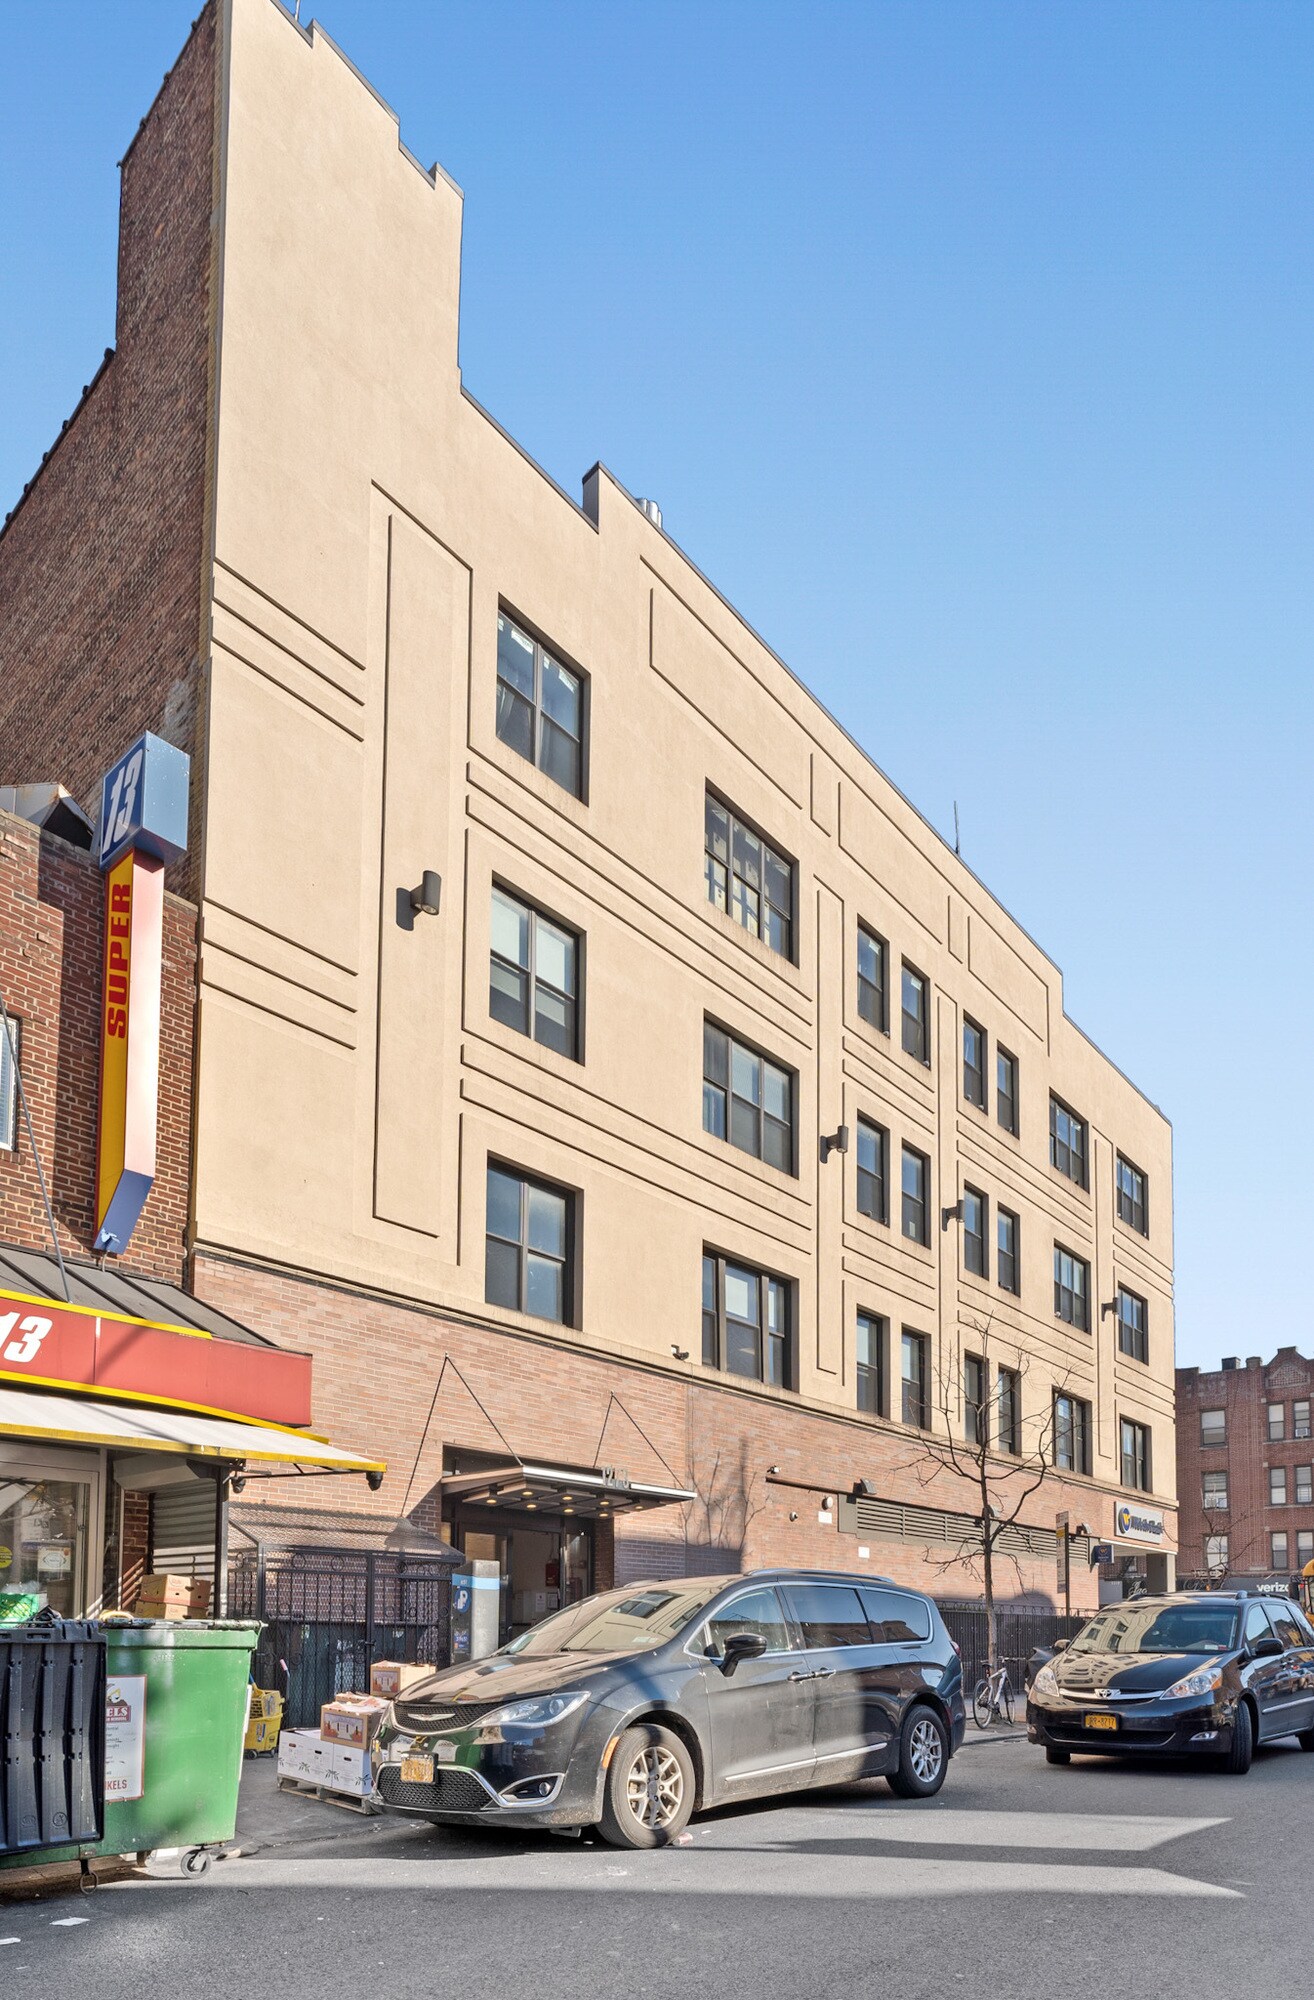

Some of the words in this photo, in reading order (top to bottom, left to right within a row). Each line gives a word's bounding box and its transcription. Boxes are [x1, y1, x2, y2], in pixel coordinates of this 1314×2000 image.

[102, 748, 143, 854] 13
[107, 884, 131, 1039] SUPER
[1257, 1582, 1289, 1593] verizo
[105, 1780, 128, 1791] KELS
